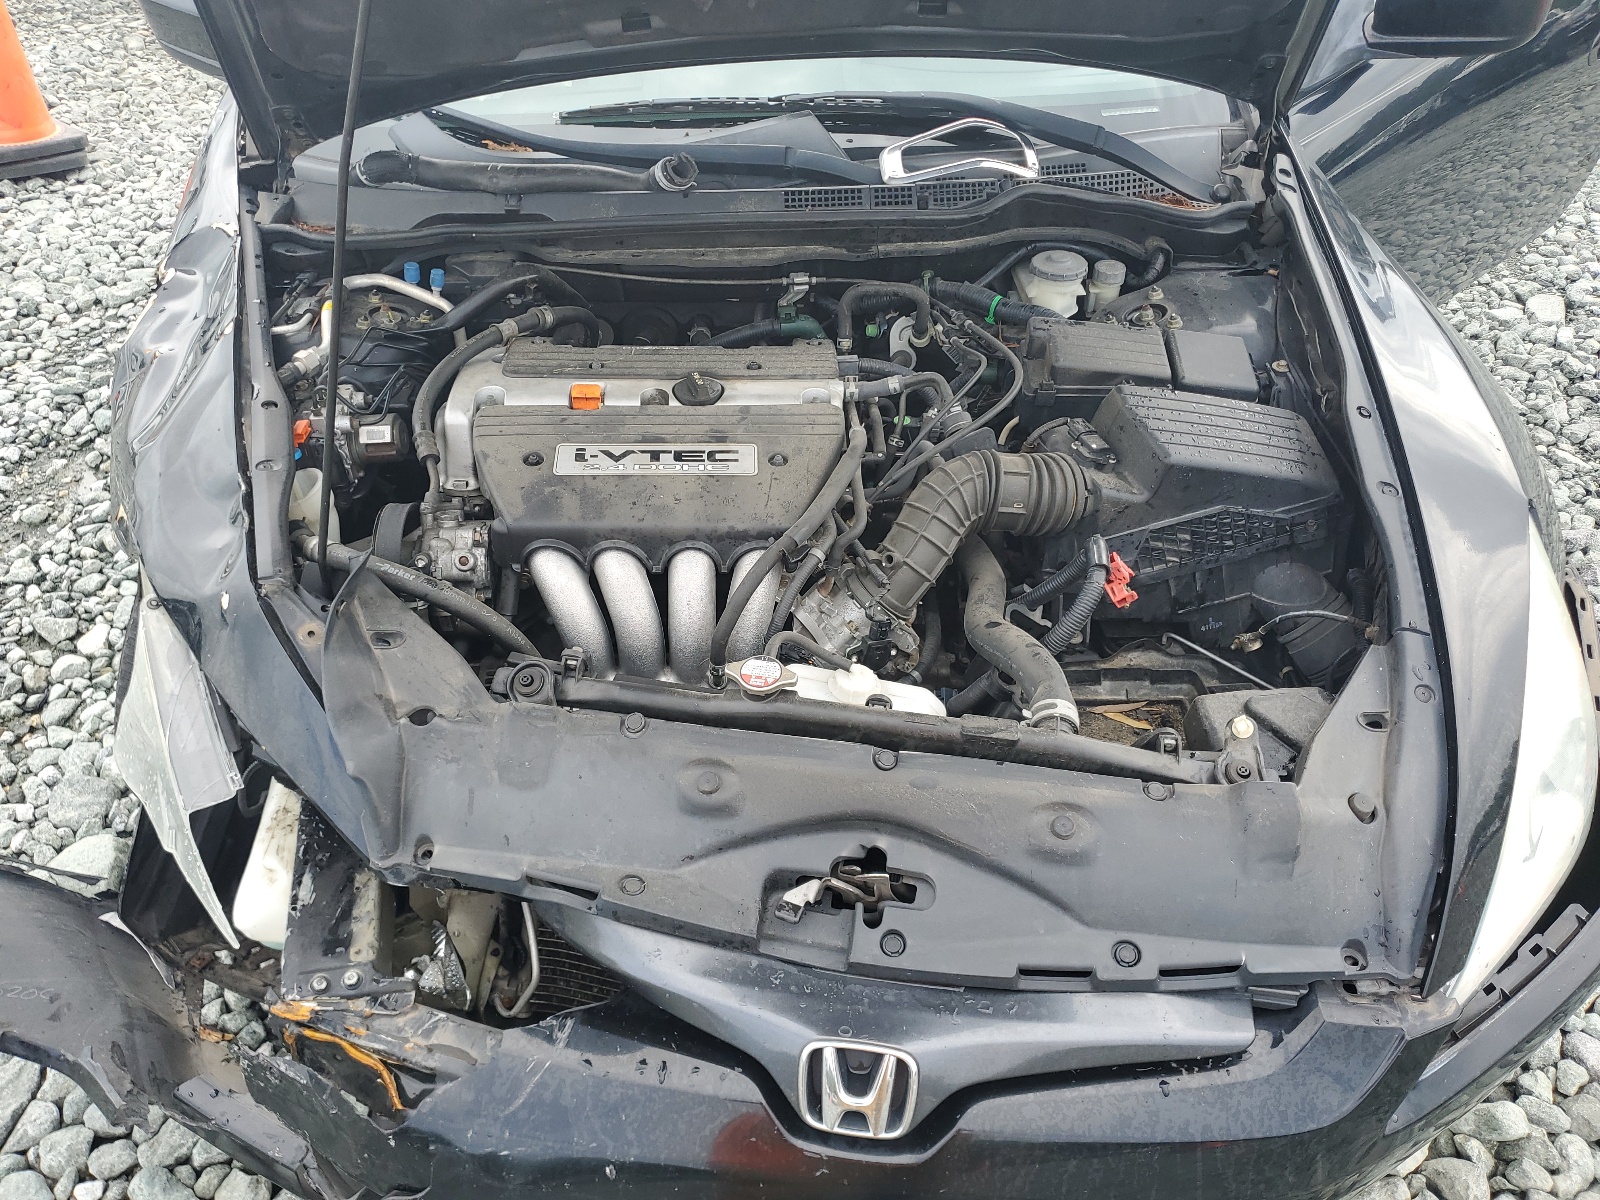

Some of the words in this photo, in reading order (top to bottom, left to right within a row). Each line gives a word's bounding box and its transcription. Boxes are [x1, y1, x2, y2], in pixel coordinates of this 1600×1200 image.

[574, 447, 740, 463] i-VTEC
[582, 463, 628, 472] 2.4
[632, 463, 731, 472] DOHC
